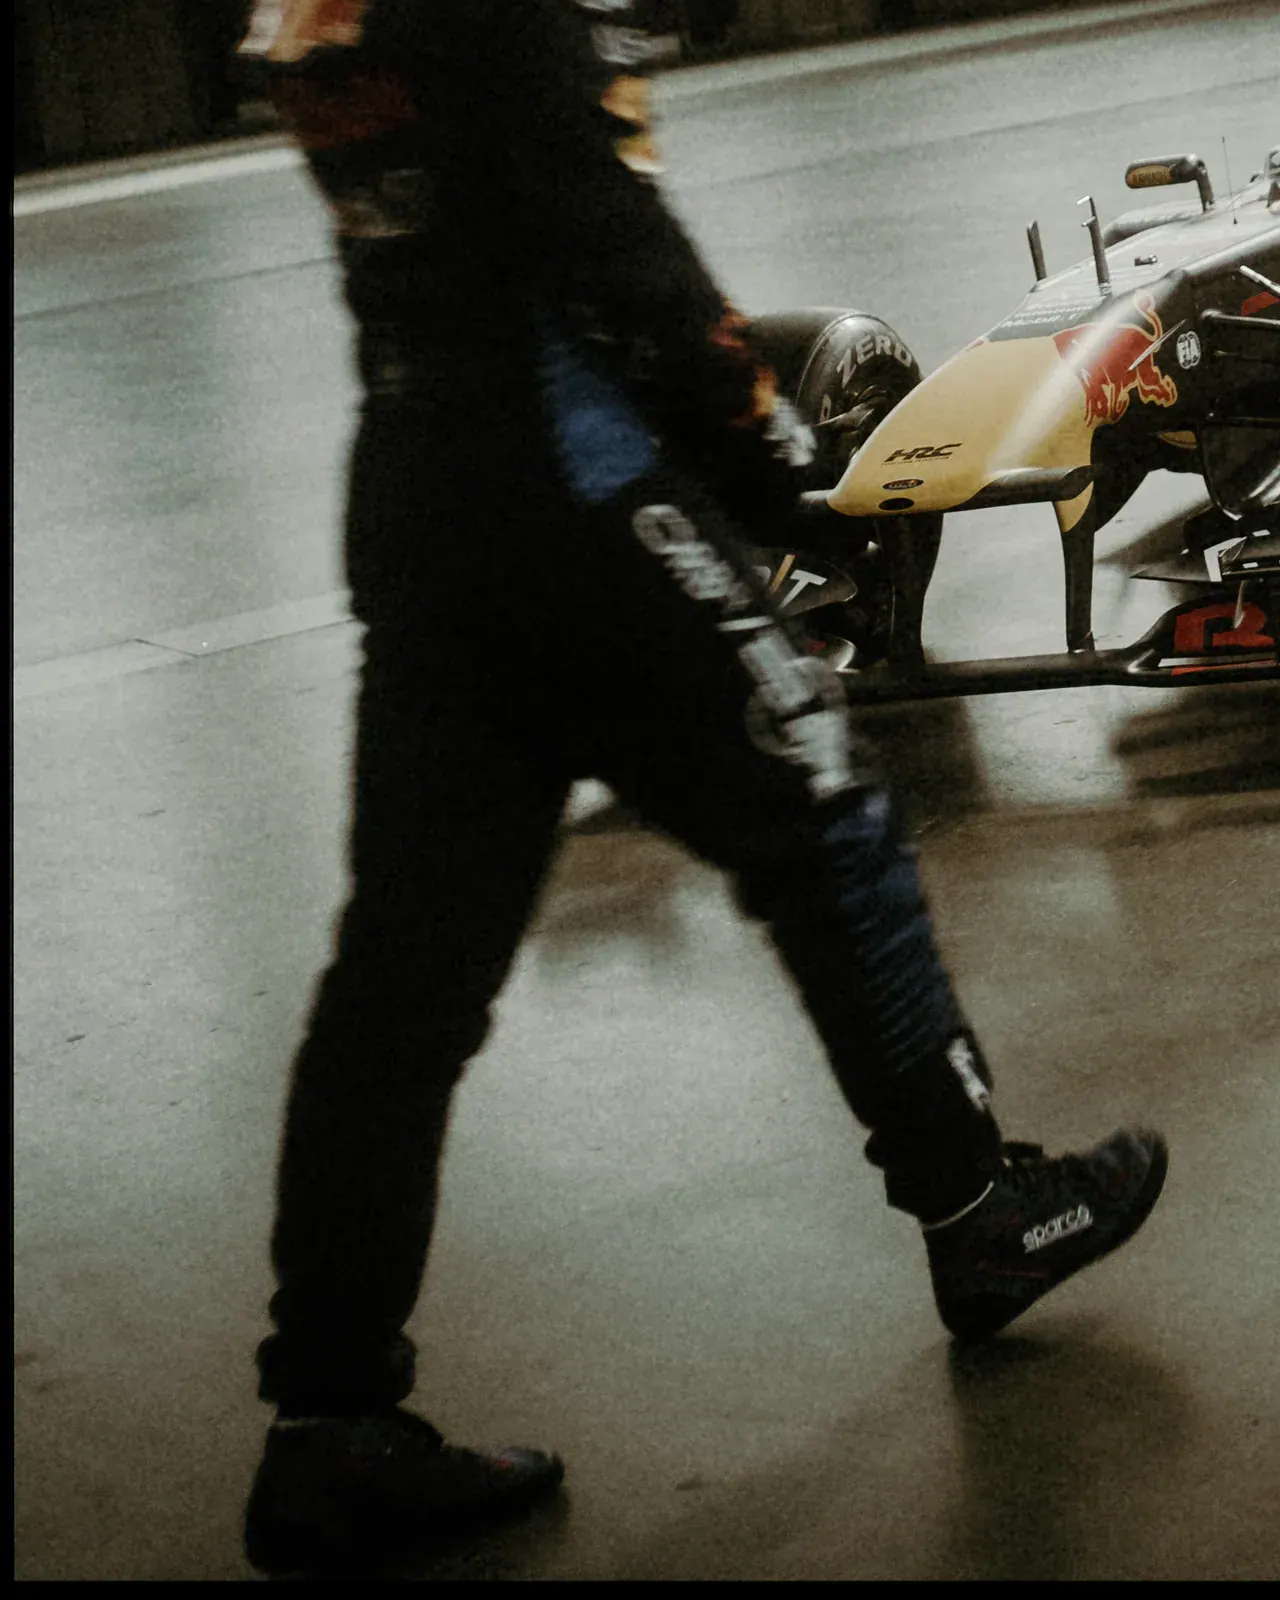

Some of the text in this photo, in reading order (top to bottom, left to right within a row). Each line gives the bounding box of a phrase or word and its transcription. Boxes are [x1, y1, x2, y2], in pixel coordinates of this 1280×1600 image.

[836, 334, 913, 389] ZERO
[884, 443, 963, 463] HRC
[1023, 1204, 1094, 1255] sparco
